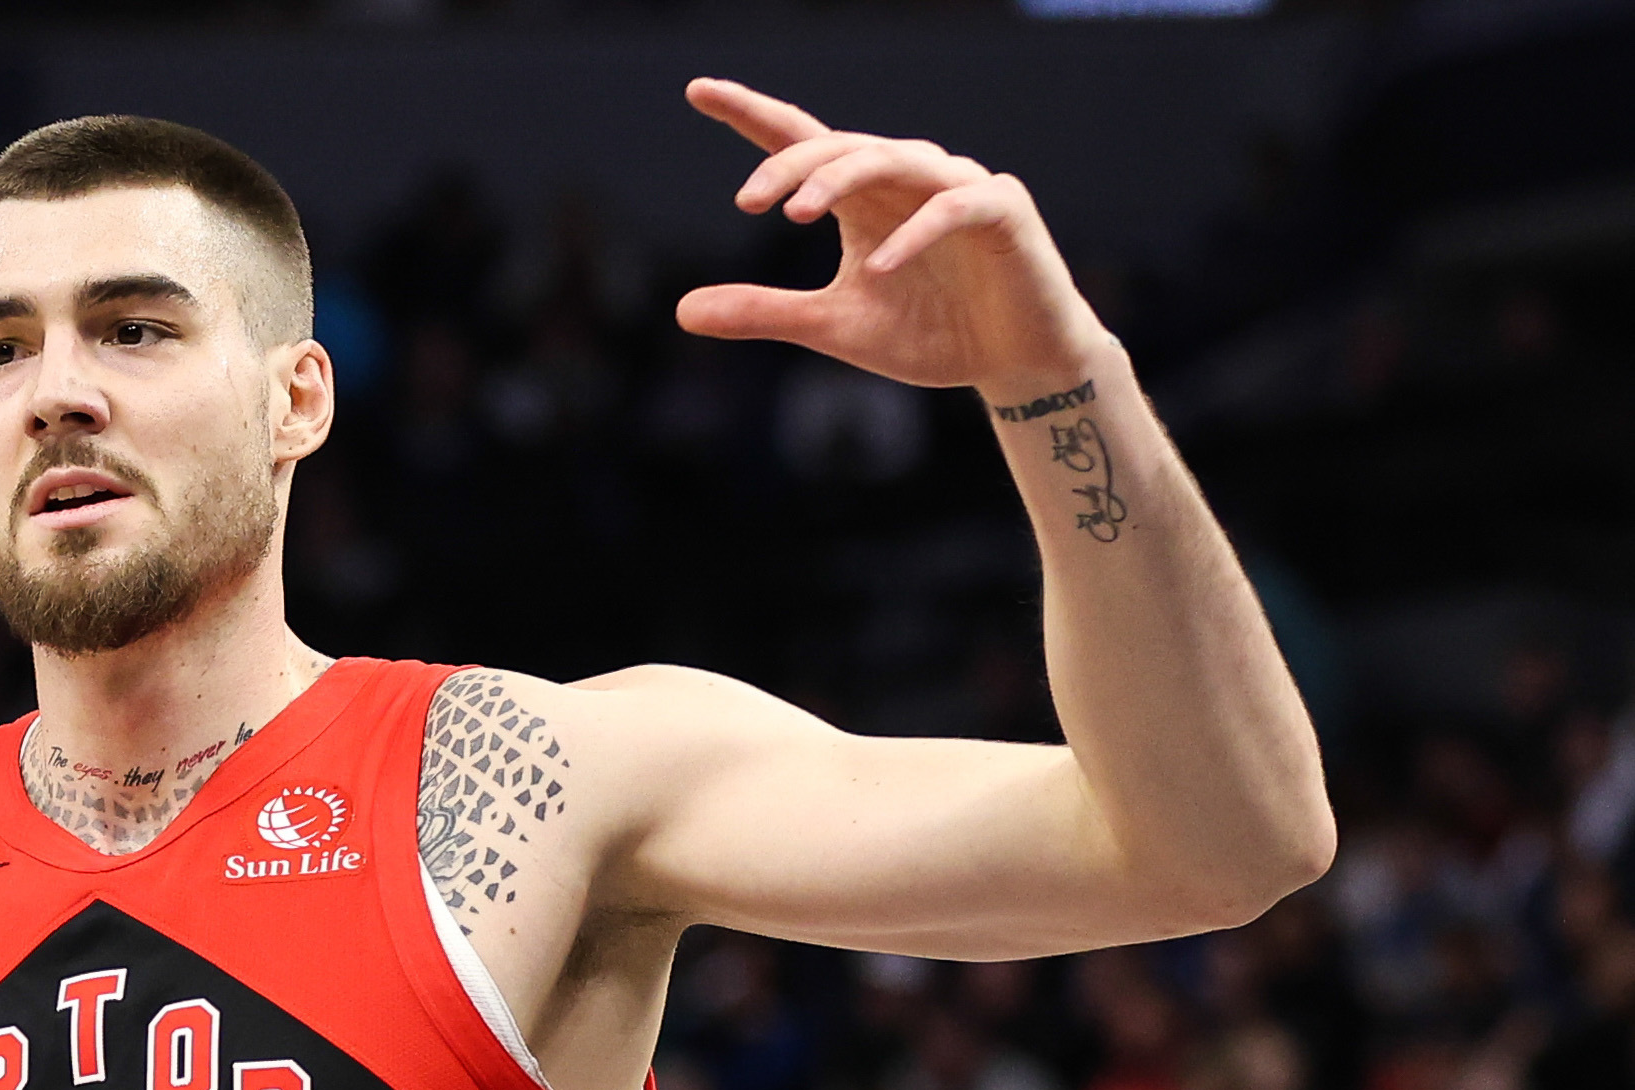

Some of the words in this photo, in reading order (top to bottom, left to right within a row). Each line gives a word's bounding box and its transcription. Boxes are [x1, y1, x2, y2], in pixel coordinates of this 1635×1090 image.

[48, 746, 68, 769] The
[123, 765, 165, 793] they
[175, 740, 226, 774] never
[224, 855, 291, 879] Sun
[298, 846, 362, 875] Life
